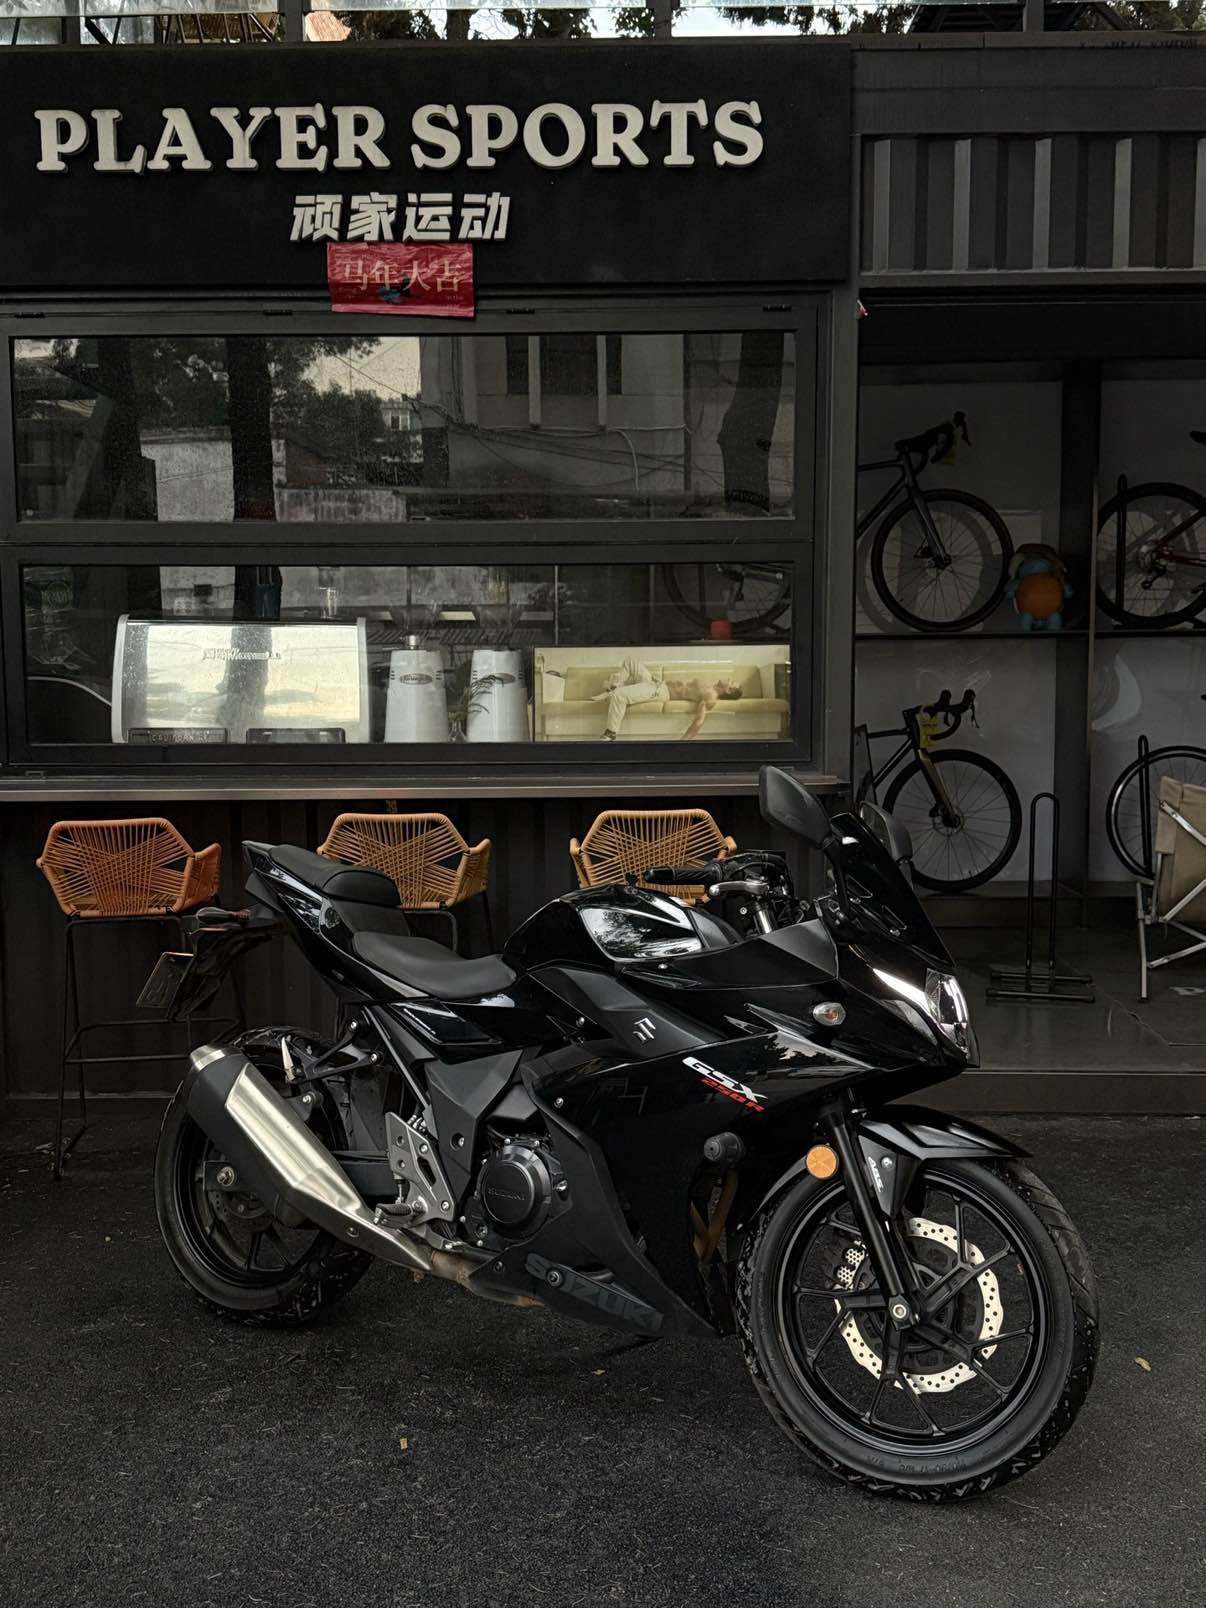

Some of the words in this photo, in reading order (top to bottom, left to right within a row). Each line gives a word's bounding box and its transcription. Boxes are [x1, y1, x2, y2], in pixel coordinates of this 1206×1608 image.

[35, 104, 392, 174] PLAYER
[410, 99, 765, 169] SPORTS
[290, 191, 511, 244] 顽家运动
[341, 256, 462, 293] 马年大吉
[682, 1056, 768, 1104] GSX
